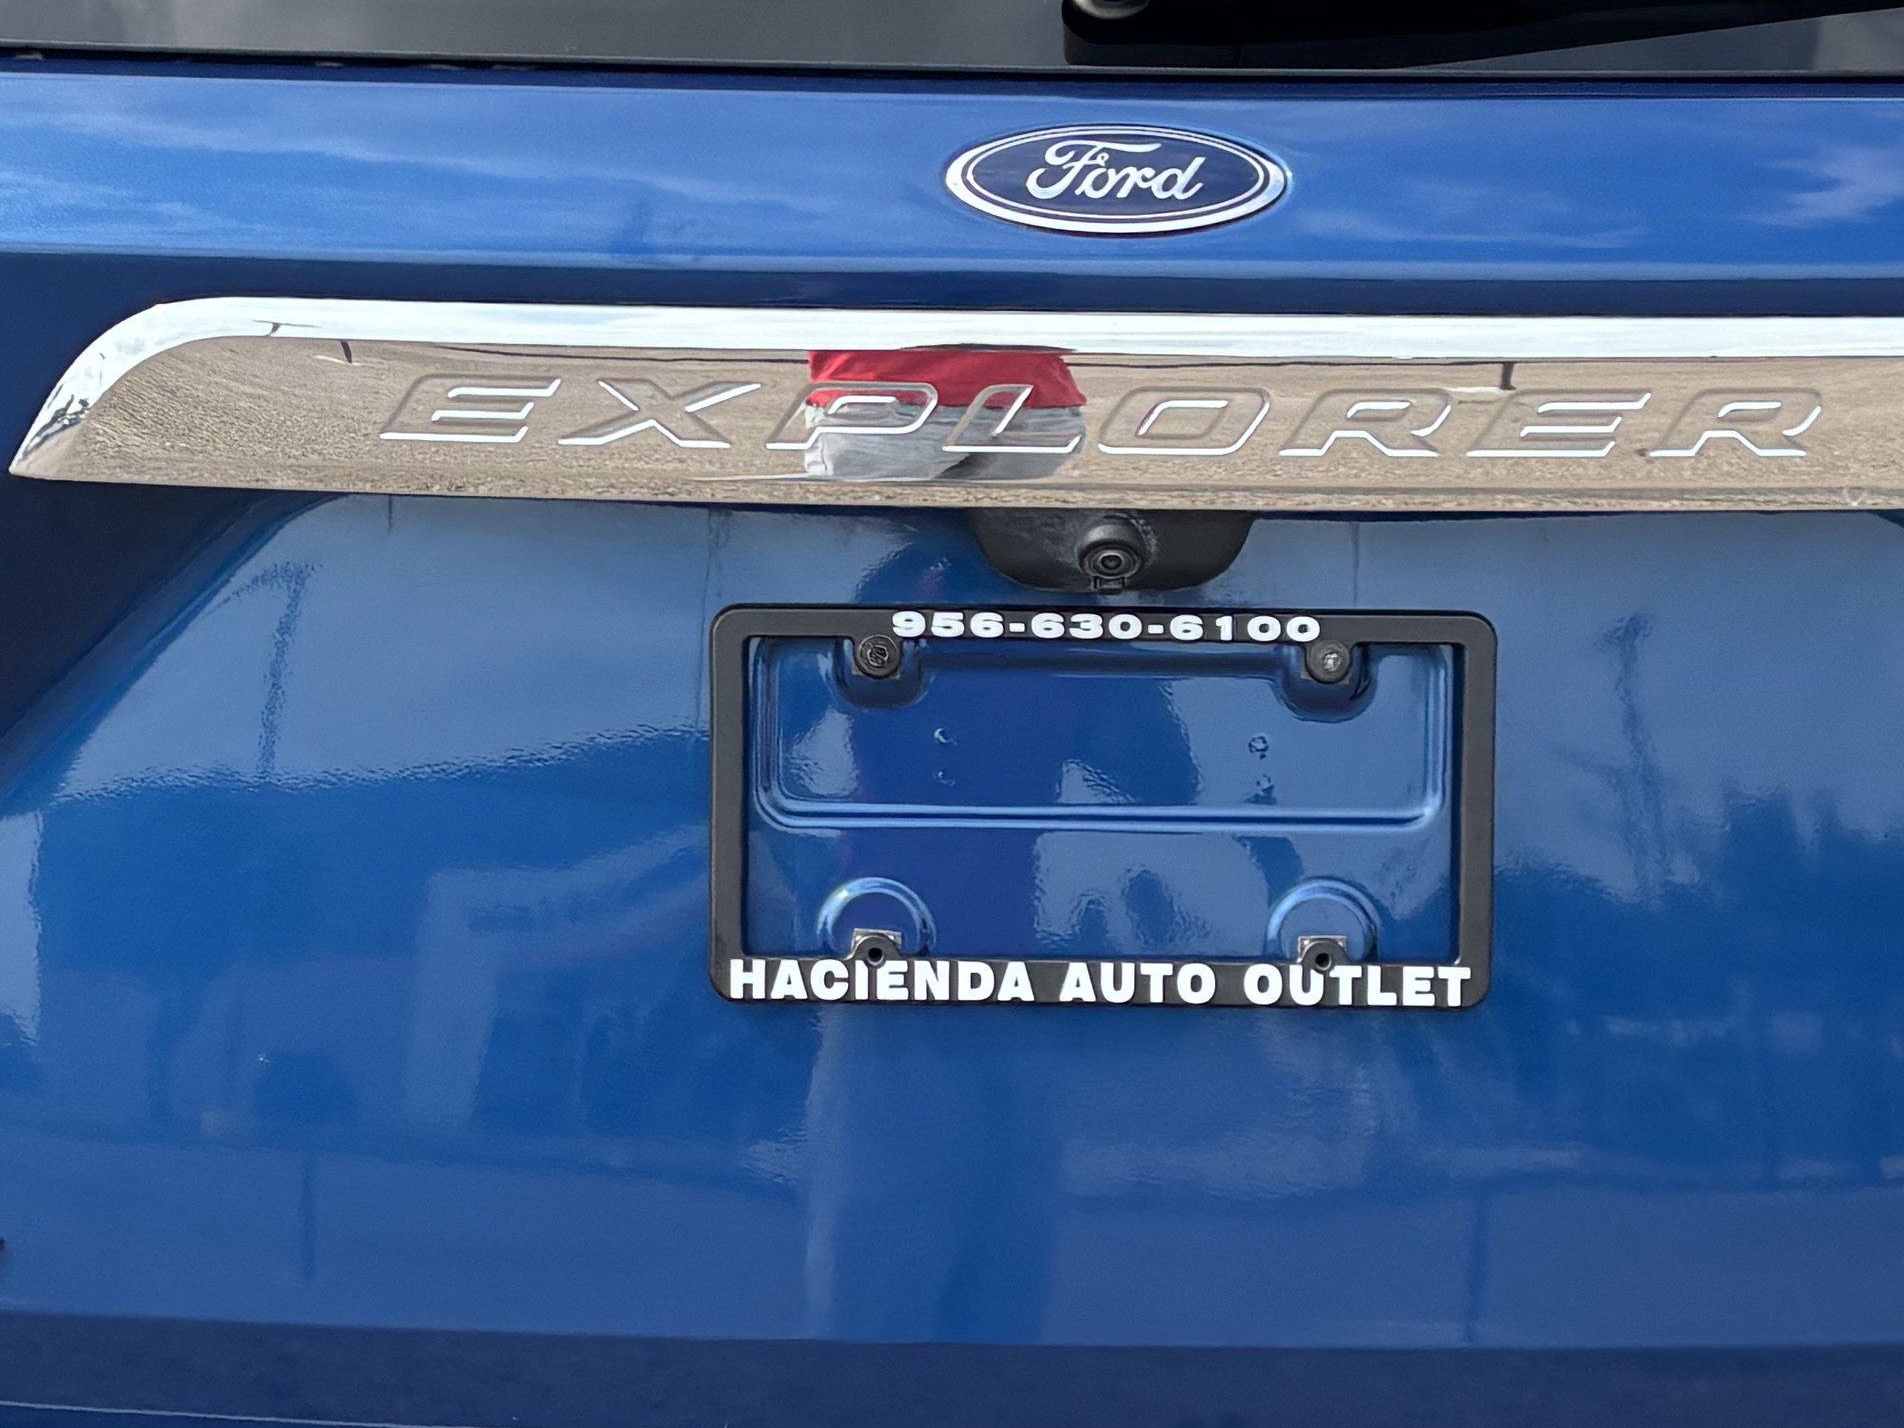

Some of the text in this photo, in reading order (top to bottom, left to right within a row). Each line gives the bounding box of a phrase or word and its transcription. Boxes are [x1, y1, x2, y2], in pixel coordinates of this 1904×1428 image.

[1025, 139, 1206, 200] Ford
[380, 373, 1822, 457] EXPLORER
[891, 609, 1321, 643] 956-630-6100
[728, 957, 1472, 1008] HACIENDA AUTO OUTLET
